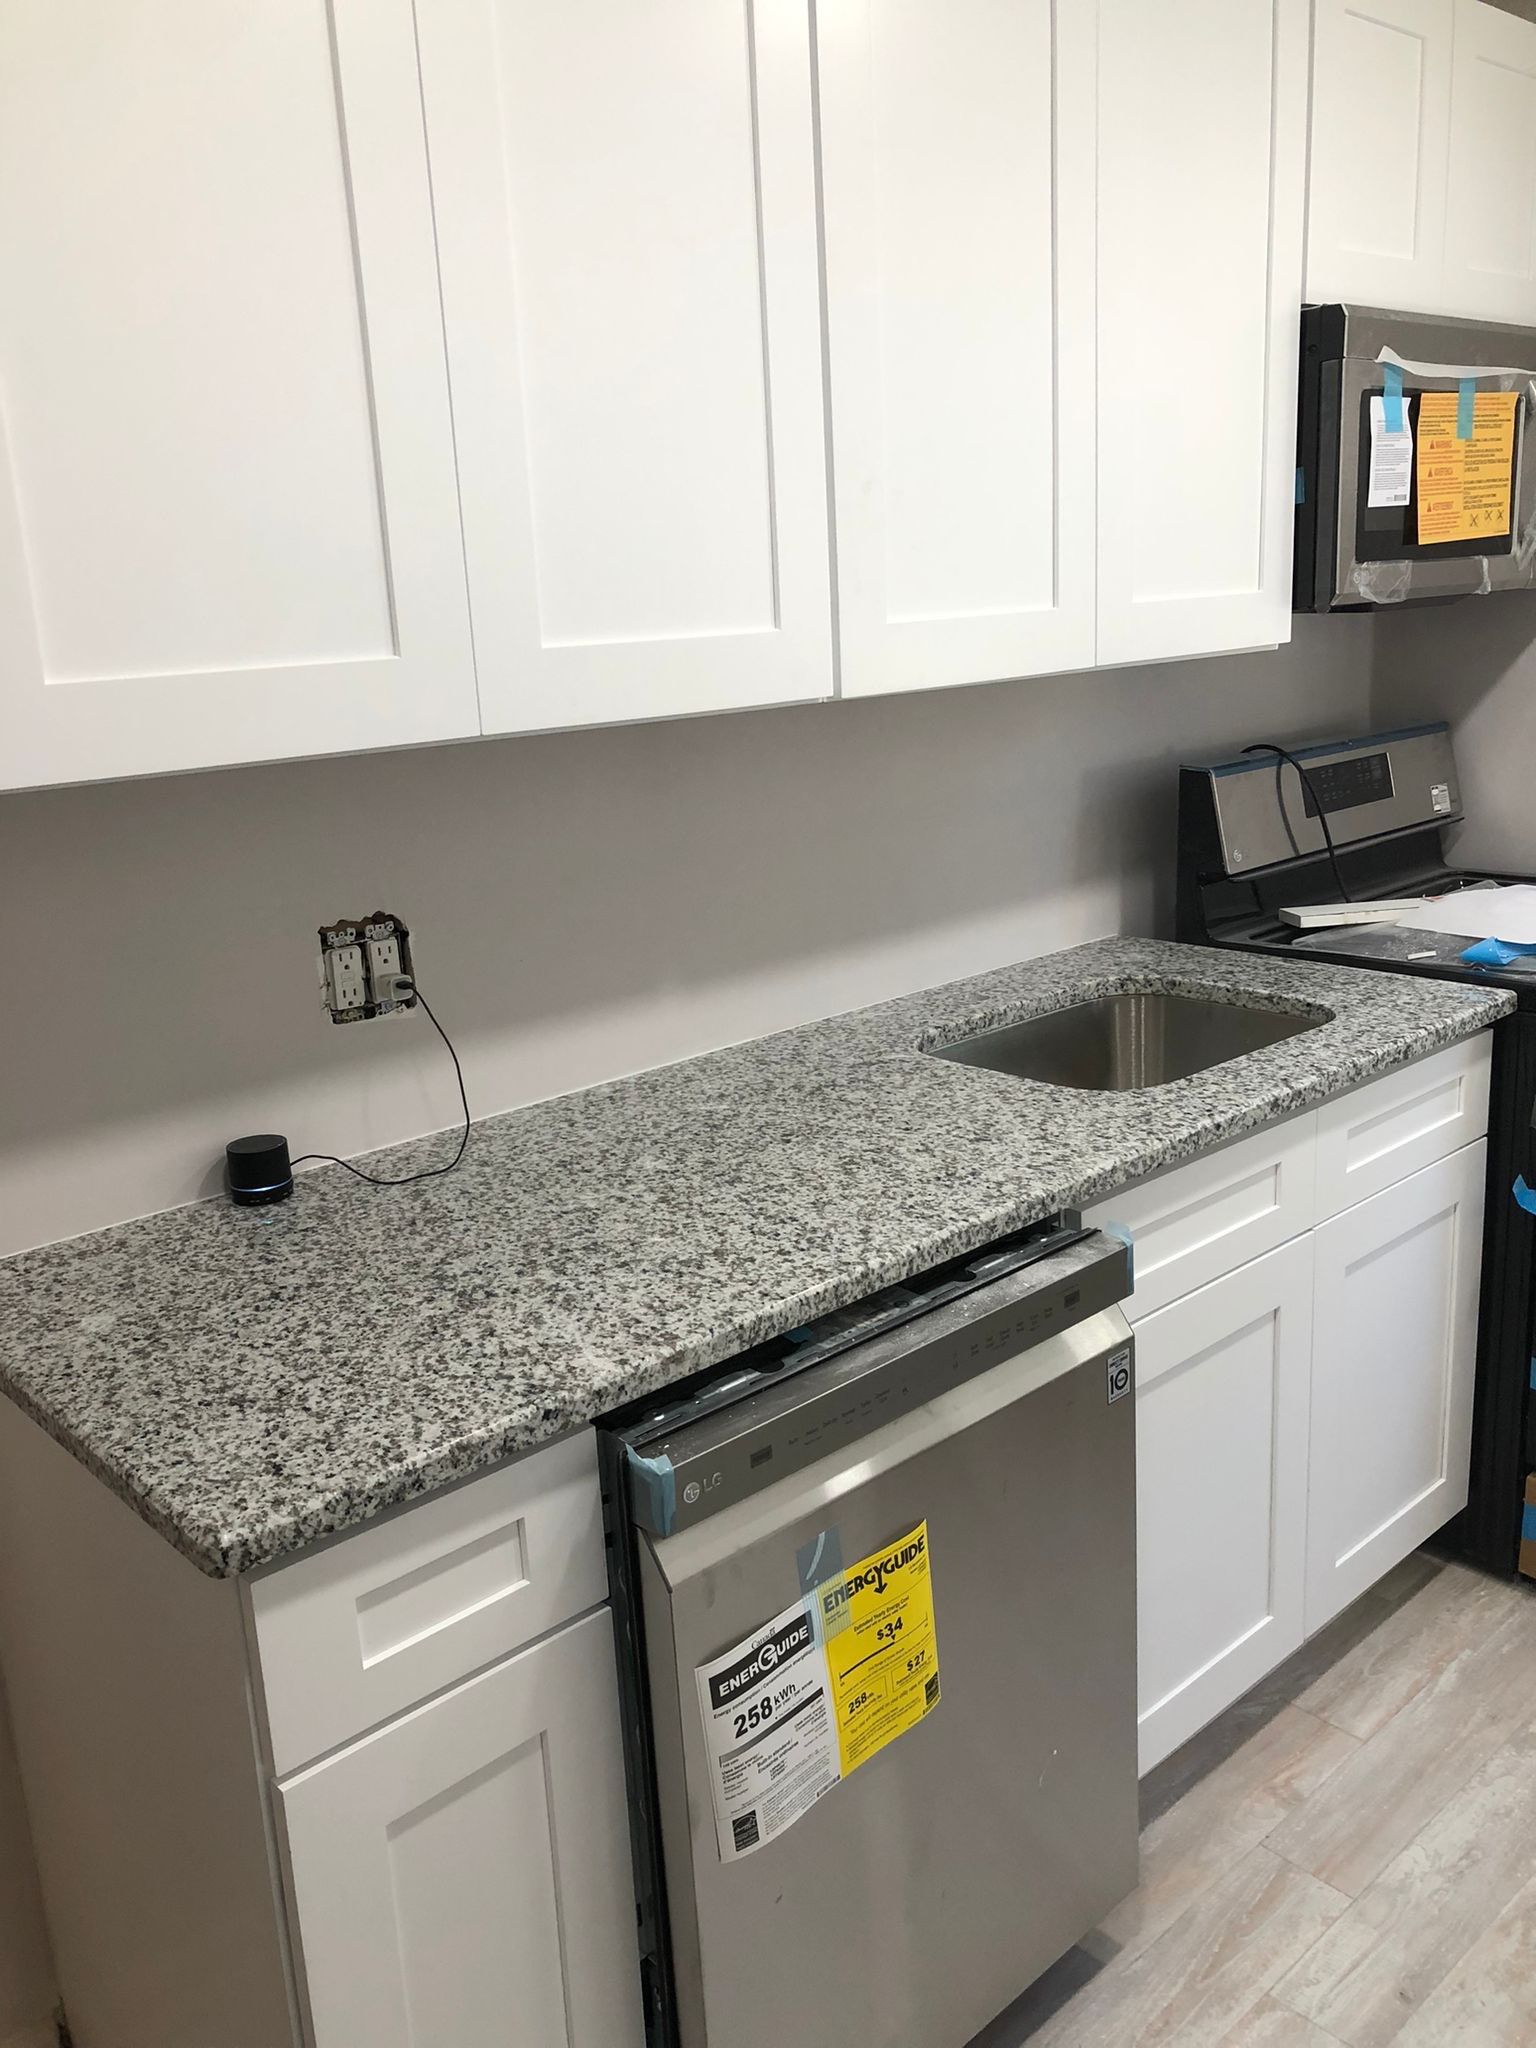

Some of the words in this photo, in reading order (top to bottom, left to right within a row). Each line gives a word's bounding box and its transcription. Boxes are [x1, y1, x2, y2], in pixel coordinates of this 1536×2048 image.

[703, 1471, 723, 1492] LG
[823, 1535, 925, 1613] ENERGYGUIDE
[876, 1616, 903, 1640] $34
[718, 1625, 809, 1697] ENERGUIDE
[733, 1695, 773, 1740] 258
[774, 1683, 797, 1706] kWh
[848, 1692, 867, 1714] 258
